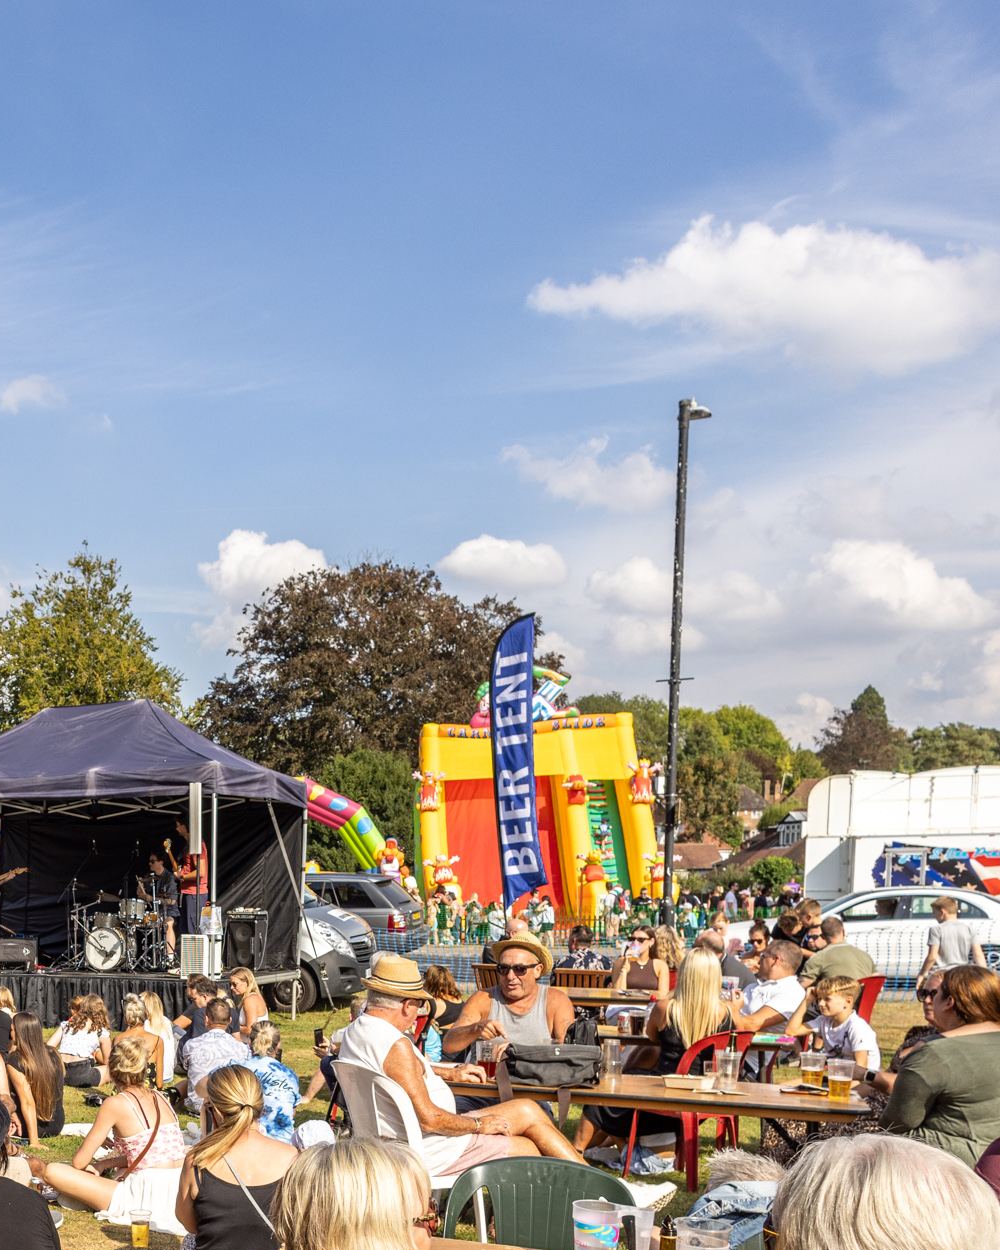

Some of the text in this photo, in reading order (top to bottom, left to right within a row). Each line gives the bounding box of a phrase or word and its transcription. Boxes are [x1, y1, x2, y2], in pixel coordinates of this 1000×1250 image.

[551, 717, 606, 731] SLIDE
[495, 651, 540, 876] BEER TENT
[254, 1069, 293, 1091] llister
